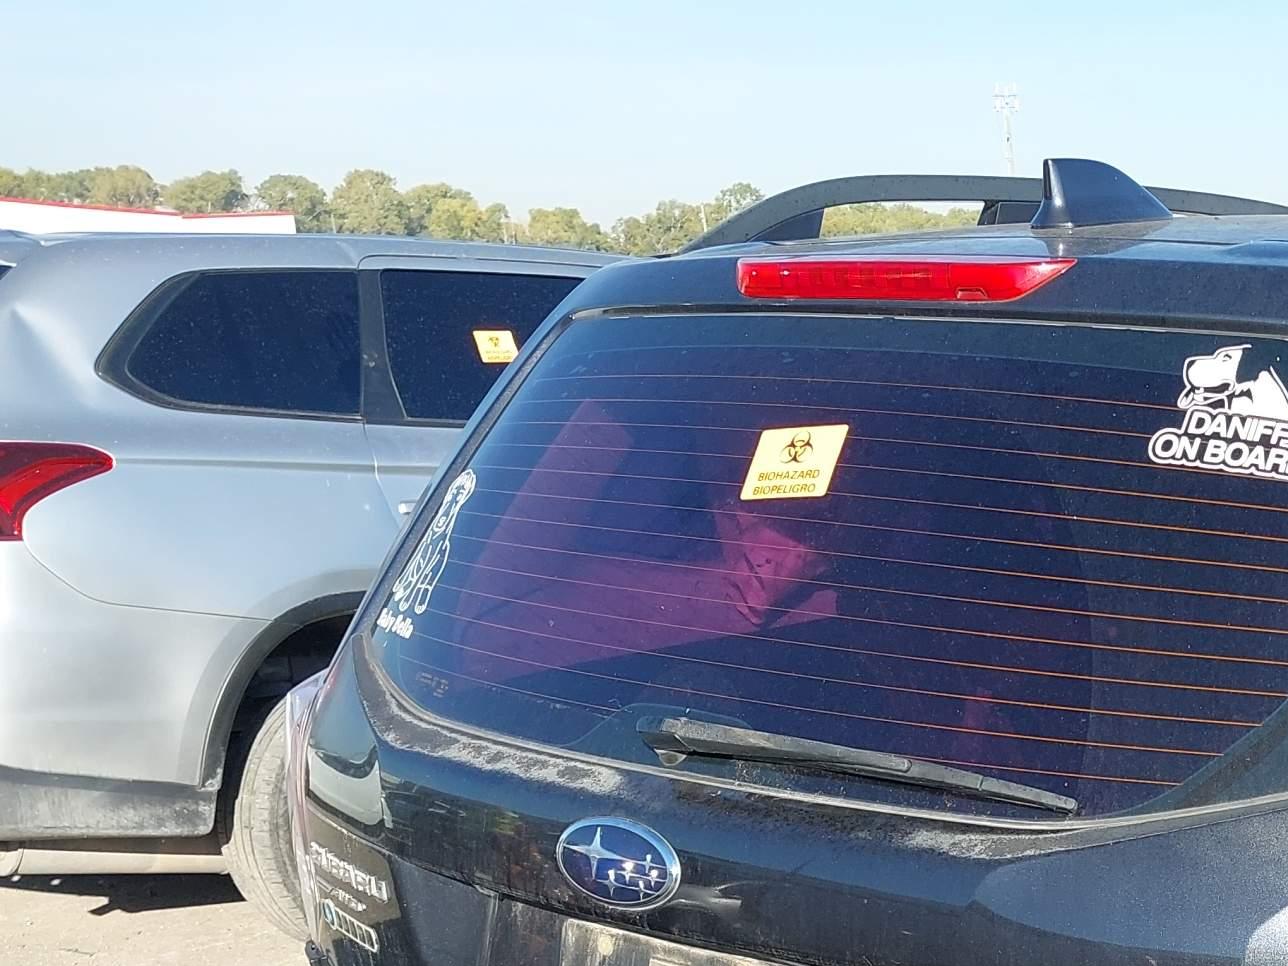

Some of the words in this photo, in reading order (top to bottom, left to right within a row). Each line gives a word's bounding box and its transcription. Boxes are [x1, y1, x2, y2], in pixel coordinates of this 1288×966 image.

[1155, 432, 1201, 461] ON
[757, 469, 820, 482] BIOHAZARD
[752, 483, 816, 496] BIOPELIGRO
[391, 614, 414, 639] Bella
